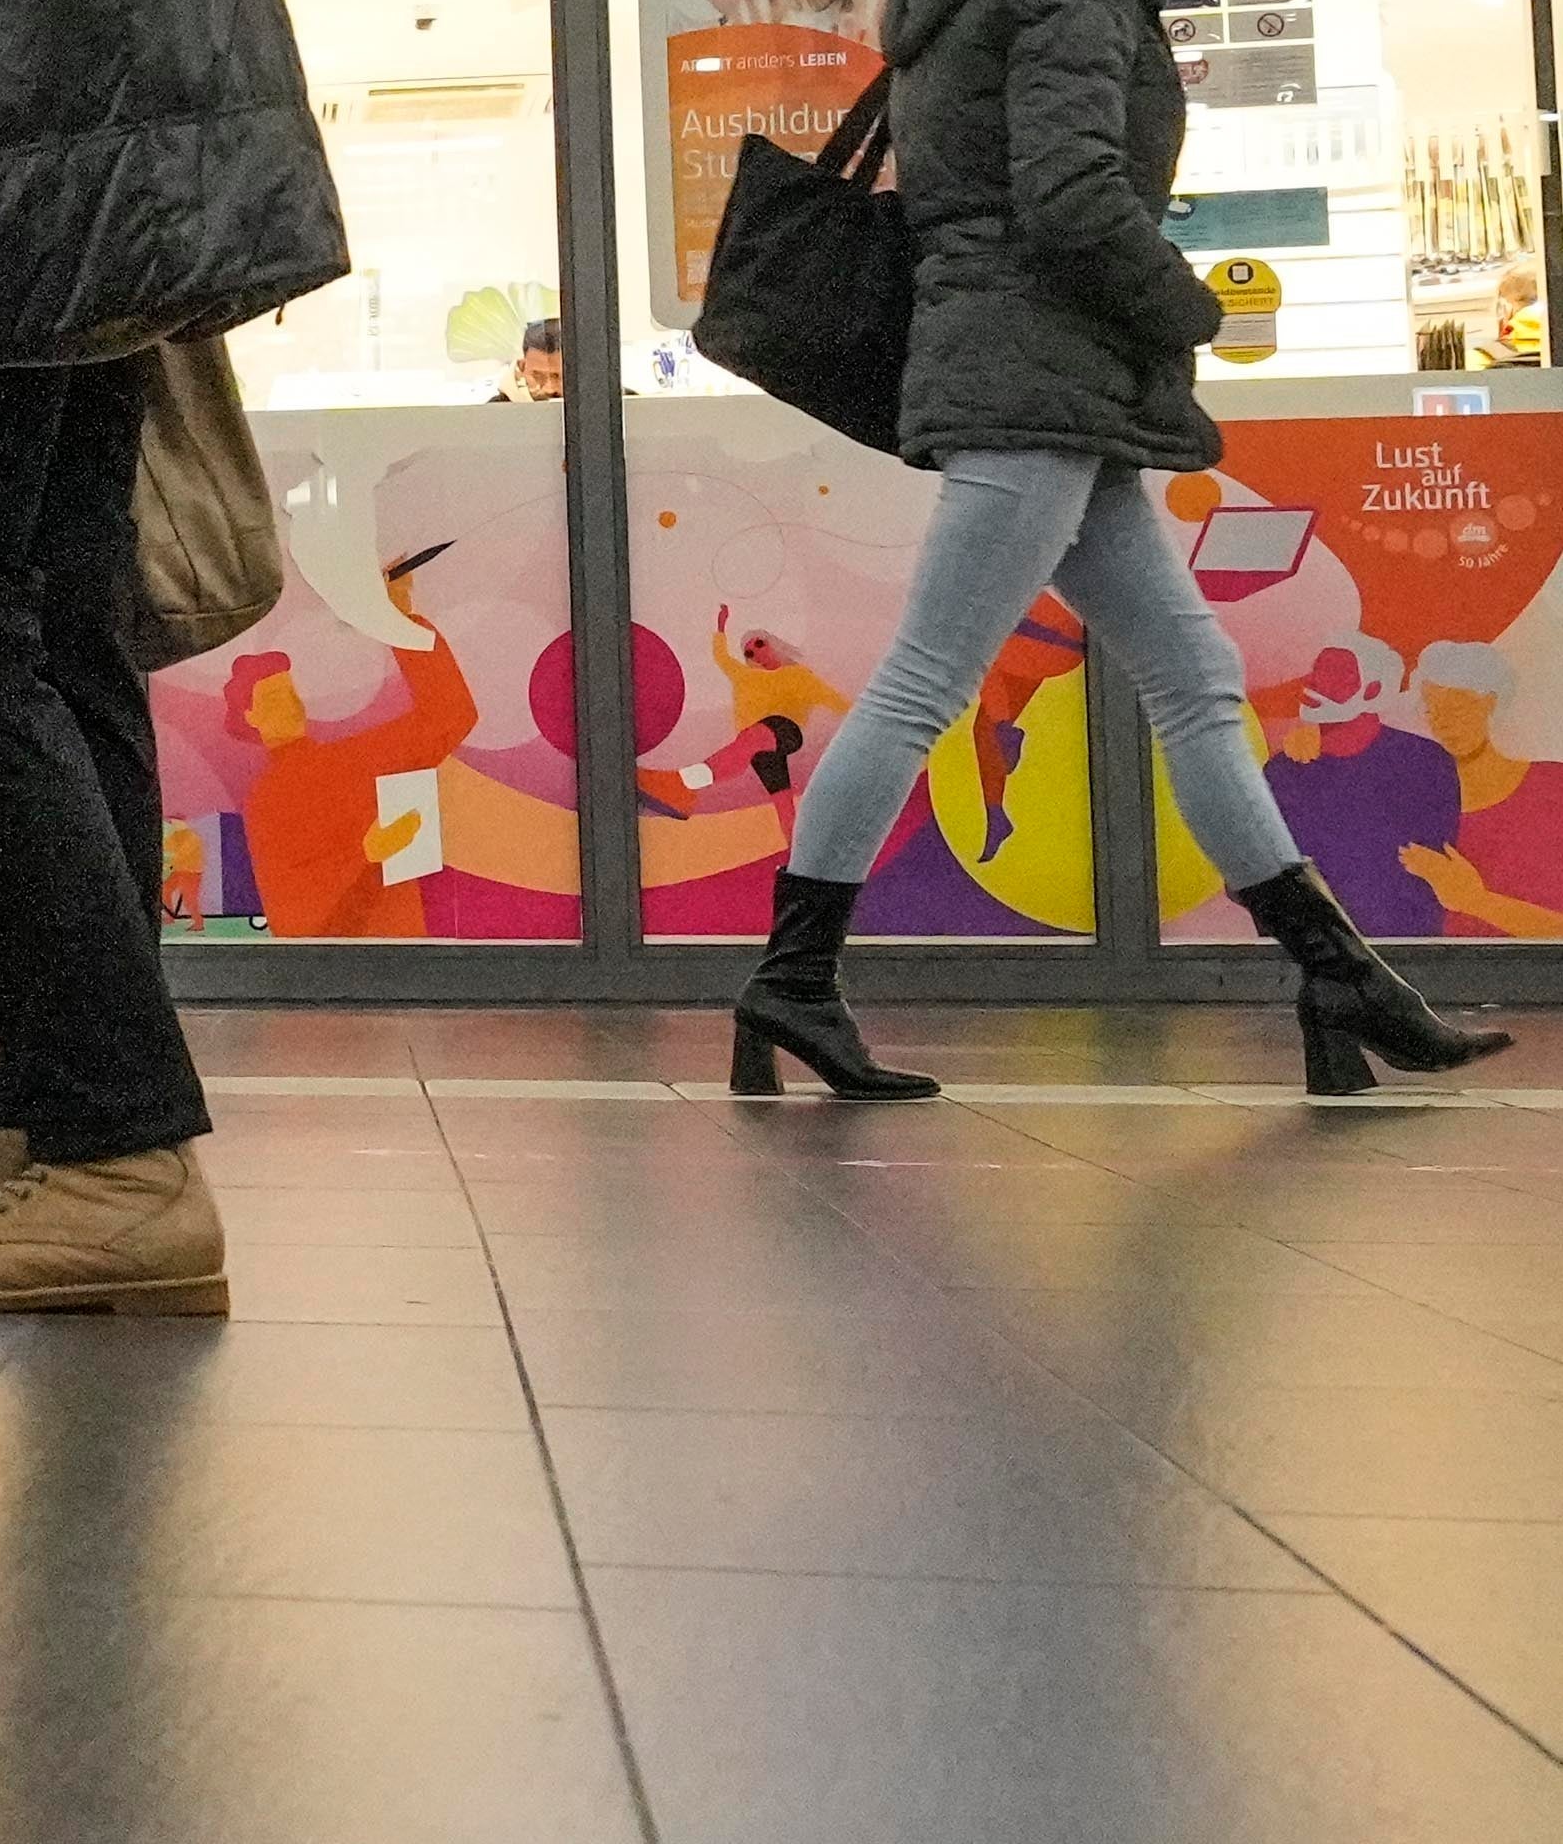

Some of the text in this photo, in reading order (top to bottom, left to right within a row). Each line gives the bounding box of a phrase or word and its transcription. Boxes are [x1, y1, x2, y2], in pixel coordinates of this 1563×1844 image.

[736, 53, 795, 70] anders
[799, 52, 847, 68] LEBEN
[1376, 442, 1443, 468] Lust
[1421, 463, 1463, 487] auf
[1362, 481, 1492, 511] Zukunft
[1459, 543, 1510, 568] 50 Jahre
